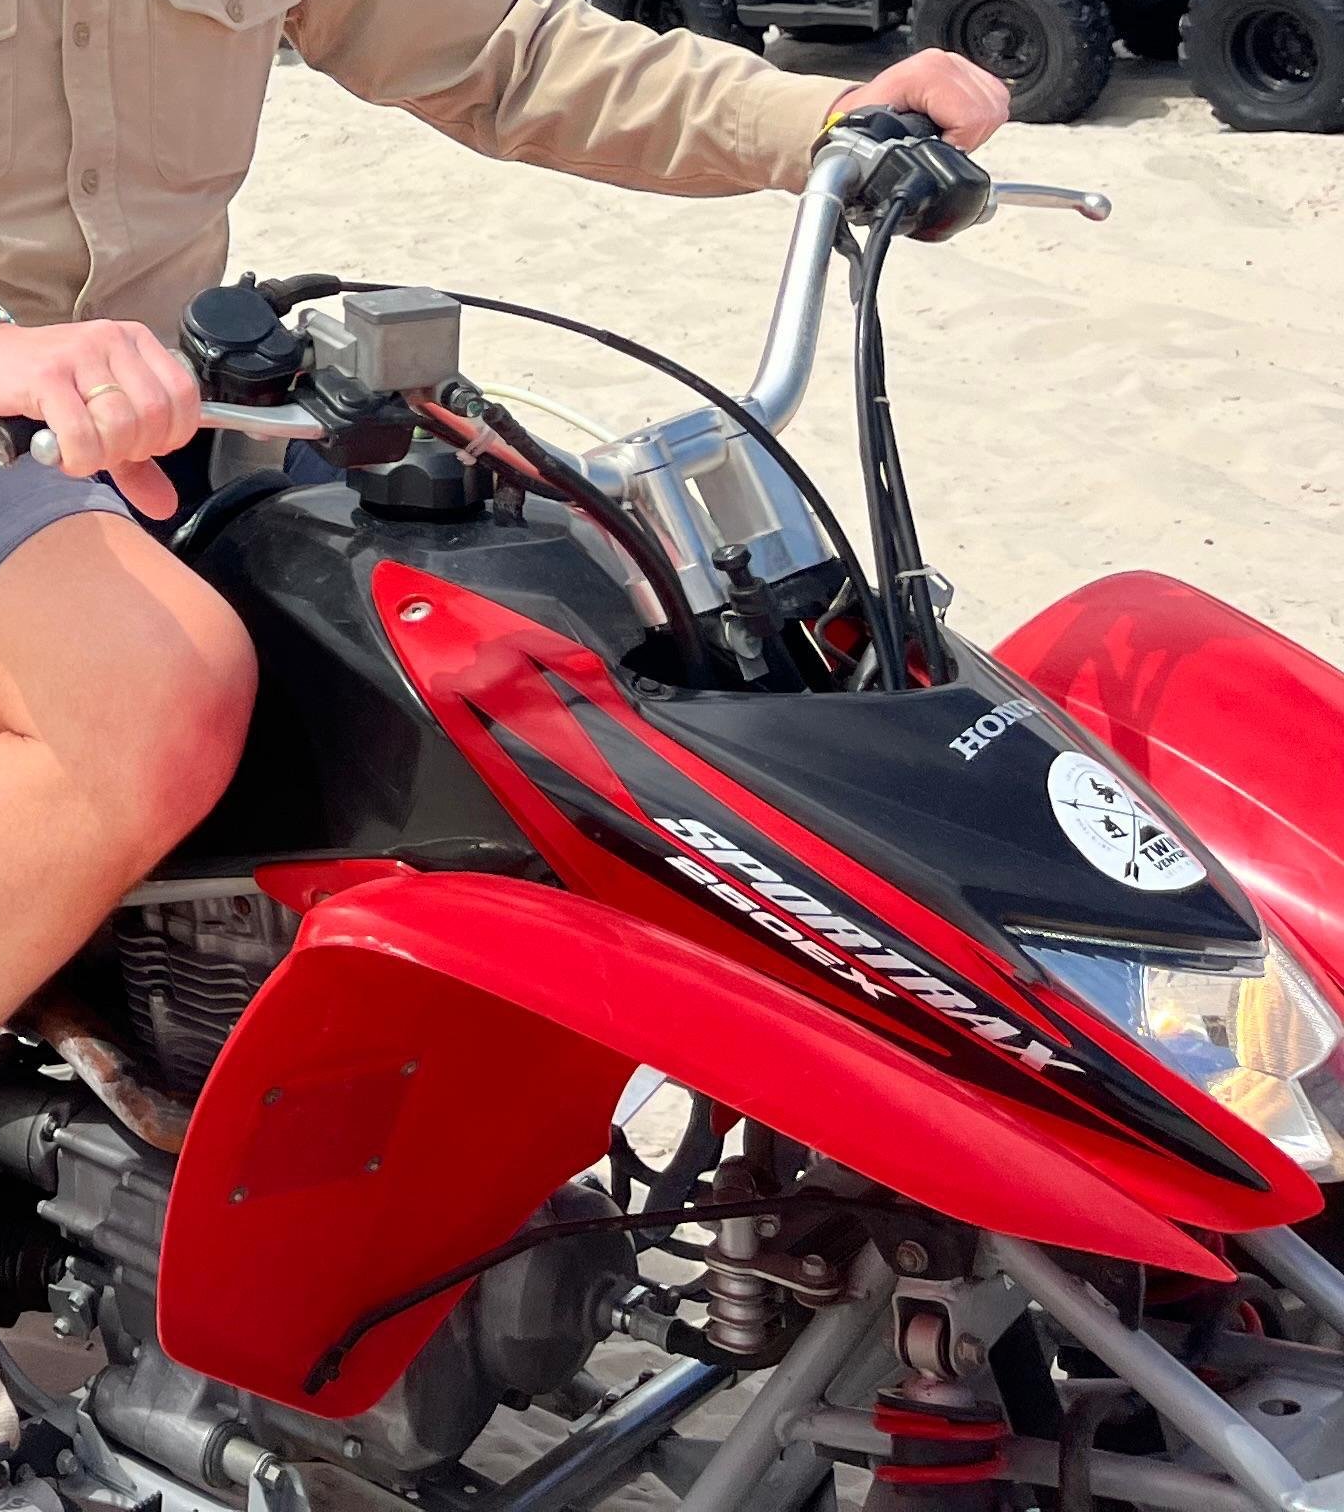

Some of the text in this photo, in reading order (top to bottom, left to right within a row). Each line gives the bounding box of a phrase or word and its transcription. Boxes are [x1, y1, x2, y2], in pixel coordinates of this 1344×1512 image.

[948, 699, 1040, 761] HON
[1153, 849, 1189, 871] VENTU
[652, 817, 1086, 1075] SPORTRAX
[664, 854, 897, 1000] 250EX
